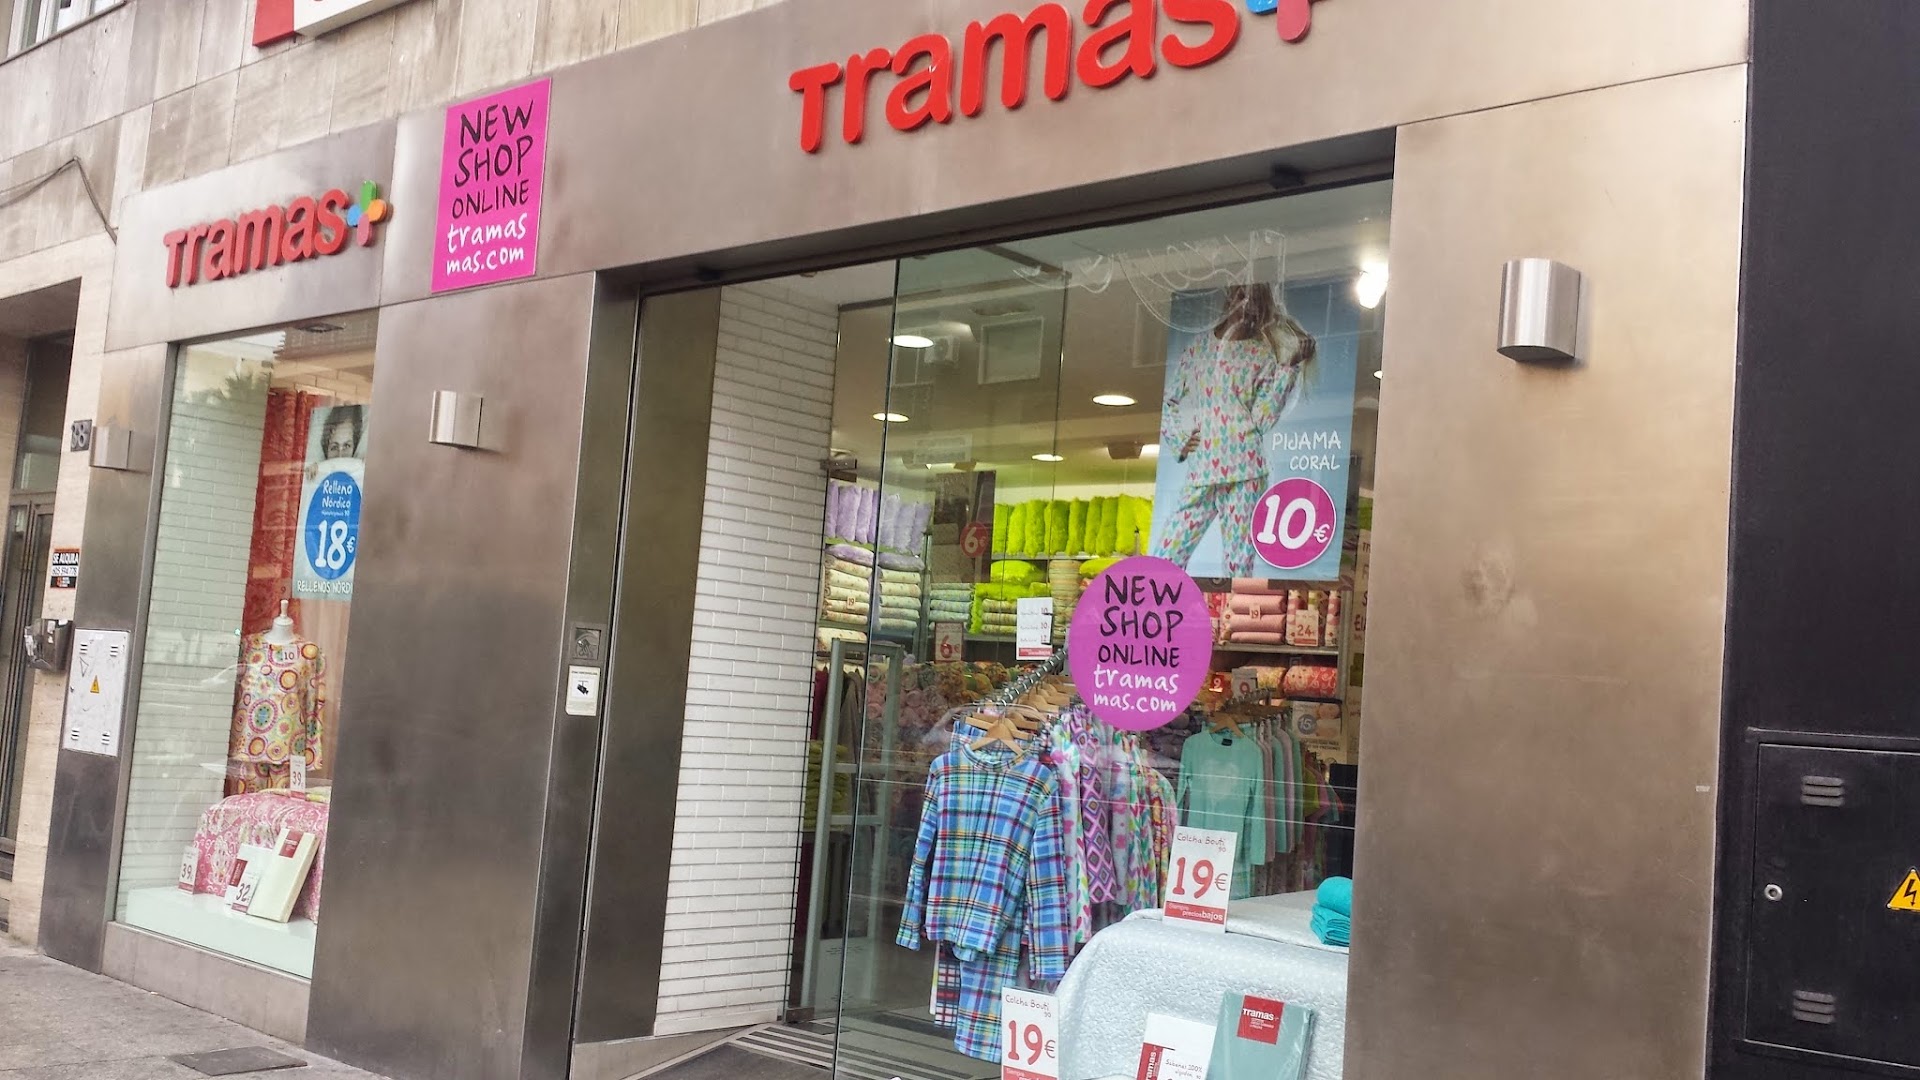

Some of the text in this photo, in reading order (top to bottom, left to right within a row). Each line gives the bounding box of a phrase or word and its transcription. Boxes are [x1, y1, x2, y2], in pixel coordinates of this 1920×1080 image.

[460, 100, 533, 148] NEW
[454, 135, 533, 187] SHOP
[452, 179, 529, 219] ONLINE
[447, 213, 528, 253] tramas
[446, 247, 525, 276] mas.com
[1272, 430, 1341, 450] PIJAMA
[1290, 454, 1340, 470] CORAL
[323, 479, 353, 495] Relleno
[1256, 494, 1330, 550] 10€
[53, 552, 79, 564] SE ALQUILA
[314, 519, 356, 571] 18€
[297, 580, 331, 594] RELLENOS
[1105, 574, 1183, 606] NEW
[1100, 606, 1184, 643] SHOP
[1251, 608, 1259, 619] 19
[1098, 643, 1180, 668] ONLINE
[1094, 664, 1179, 694] tramas
[1093, 692, 1177, 713] mas.com
[1176, 833, 1202, 844] Colcha
[1172, 856, 1228, 899] 19€
[1005, 994, 1029, 1007] Colcha
[1007, 1019, 1056, 1066] 19€
